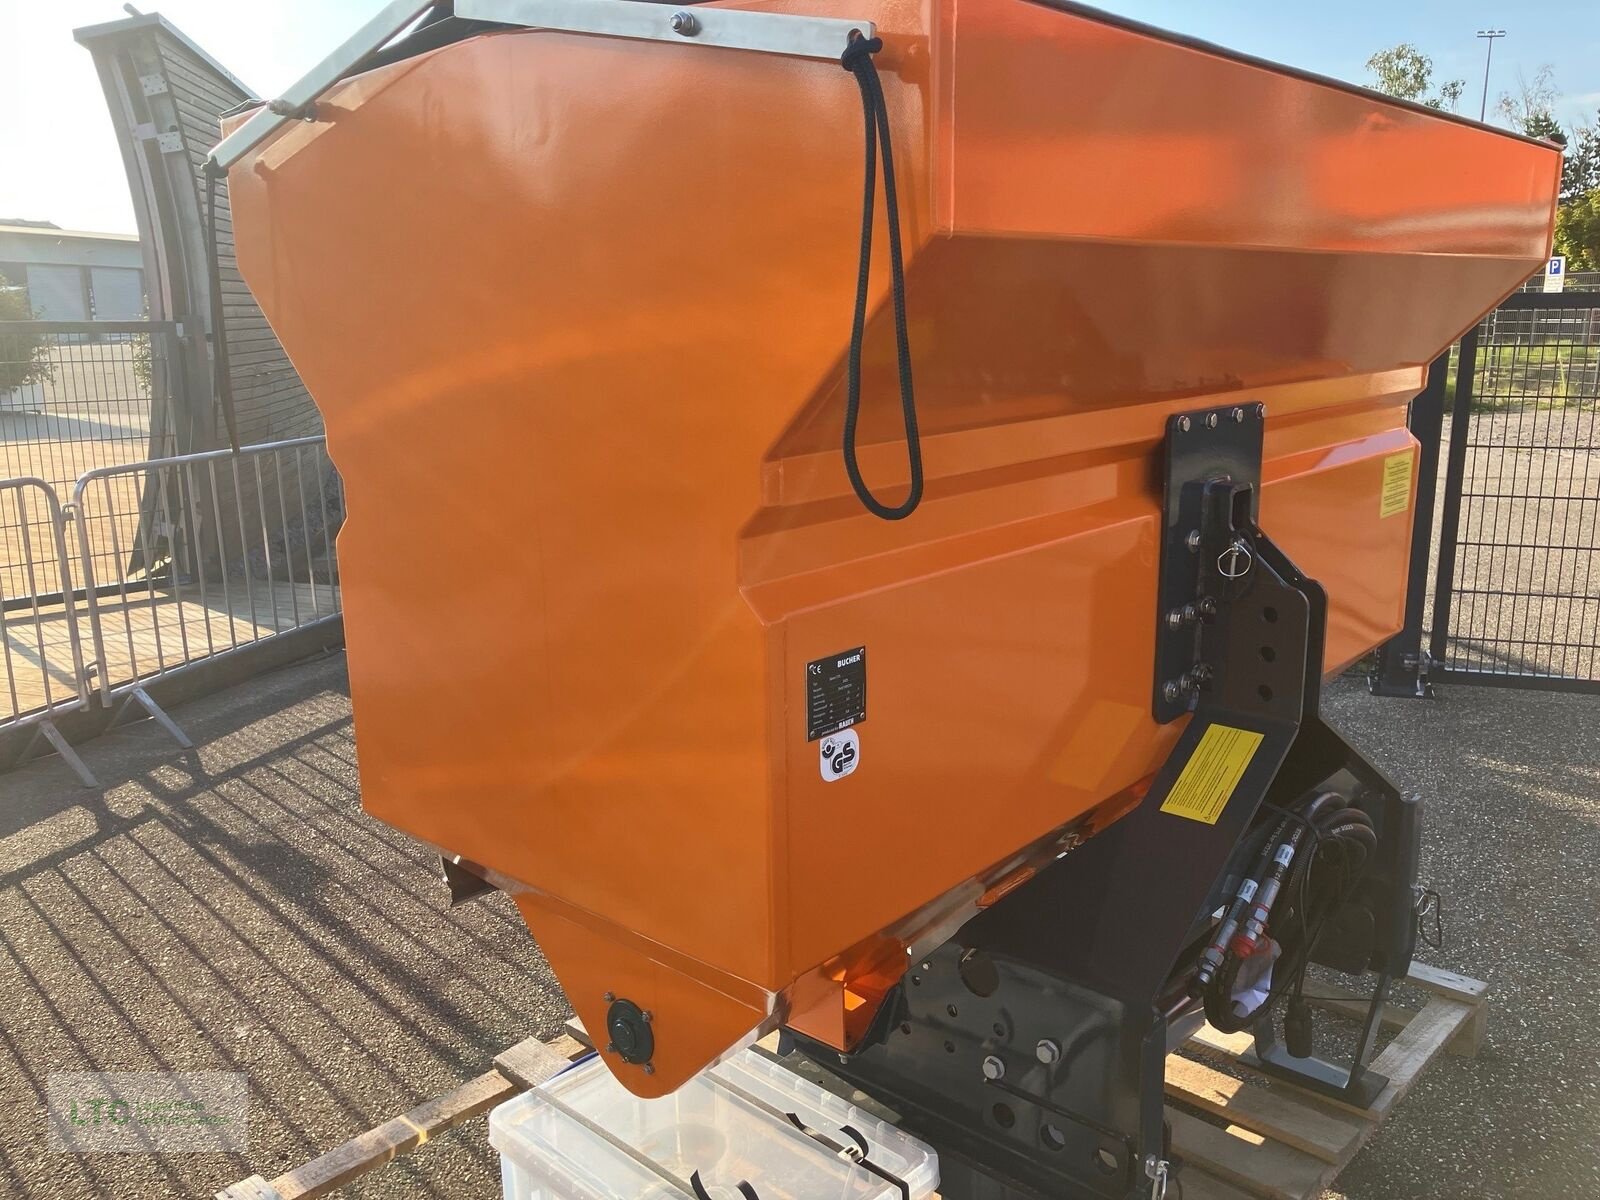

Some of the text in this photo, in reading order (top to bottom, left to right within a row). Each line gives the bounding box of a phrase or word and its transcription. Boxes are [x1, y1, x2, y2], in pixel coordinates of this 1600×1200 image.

[1551, 260, 1559, 274] P
[837, 654, 860, 668] BUCHER
[832, 741, 855, 773] GS
